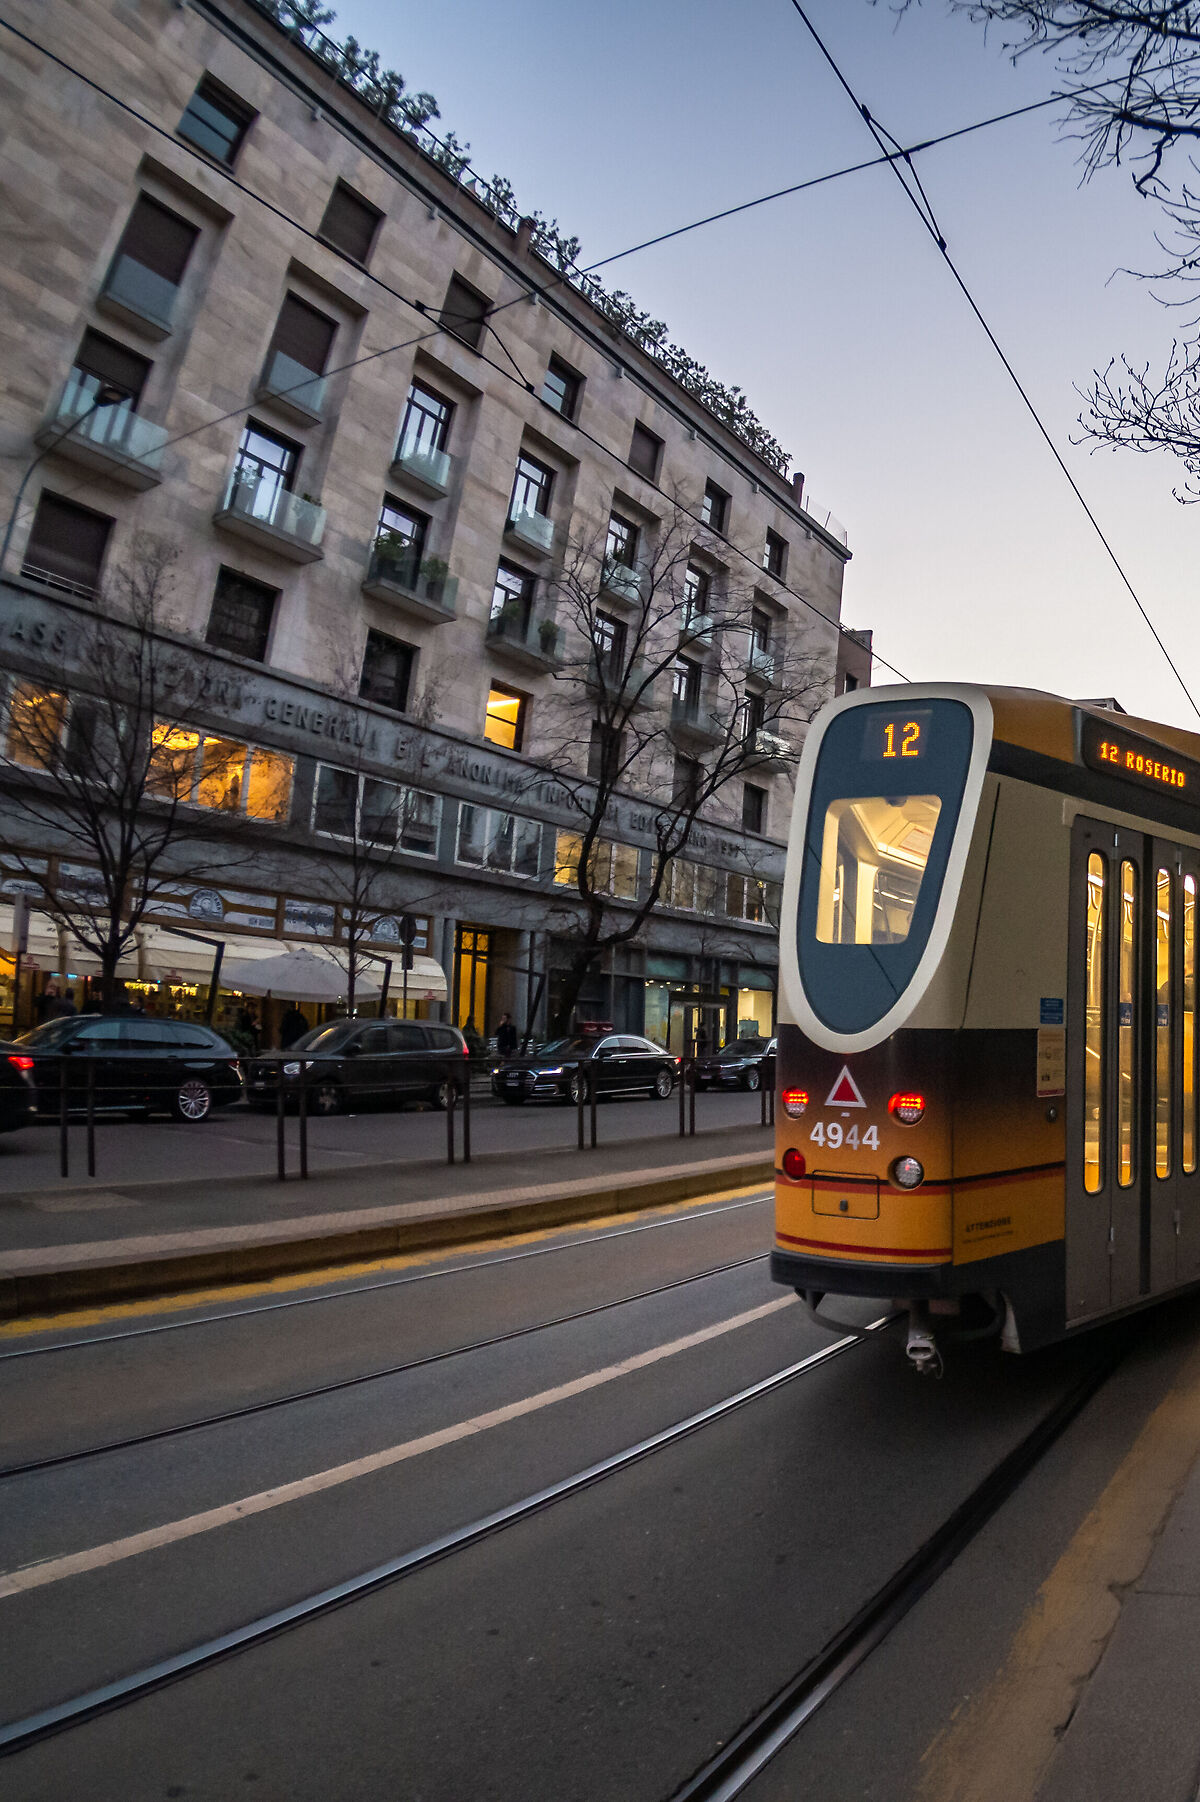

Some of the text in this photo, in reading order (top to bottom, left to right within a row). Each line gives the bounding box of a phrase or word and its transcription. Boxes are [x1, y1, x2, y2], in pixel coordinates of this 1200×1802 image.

[263, 697, 378, 751] GENERALI
[883, 722, 921, 758] 12
[1099, 740, 1186, 789] 12 ROSERIO
[809, 1122, 881, 1151] 4944
